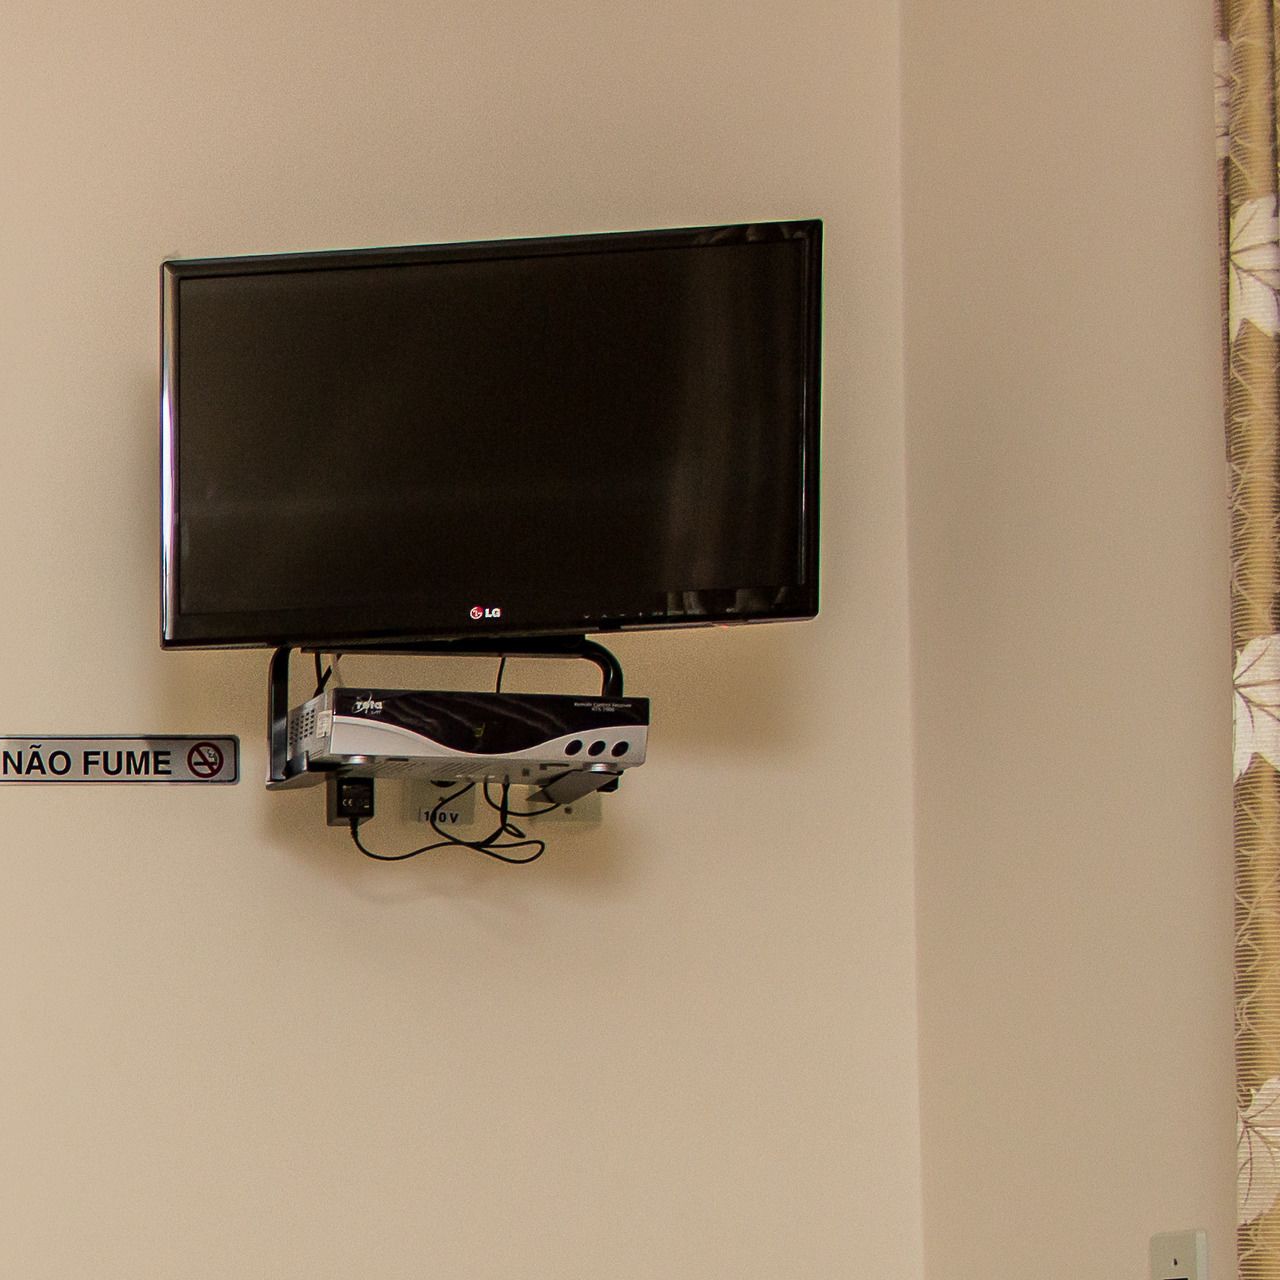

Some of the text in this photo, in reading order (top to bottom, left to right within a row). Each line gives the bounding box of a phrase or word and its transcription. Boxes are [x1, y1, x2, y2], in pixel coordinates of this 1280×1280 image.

[485, 608, 501, 618] LG
[2, 743, 172, 776] NÃO FUME
[450, 813, 459, 824] V
